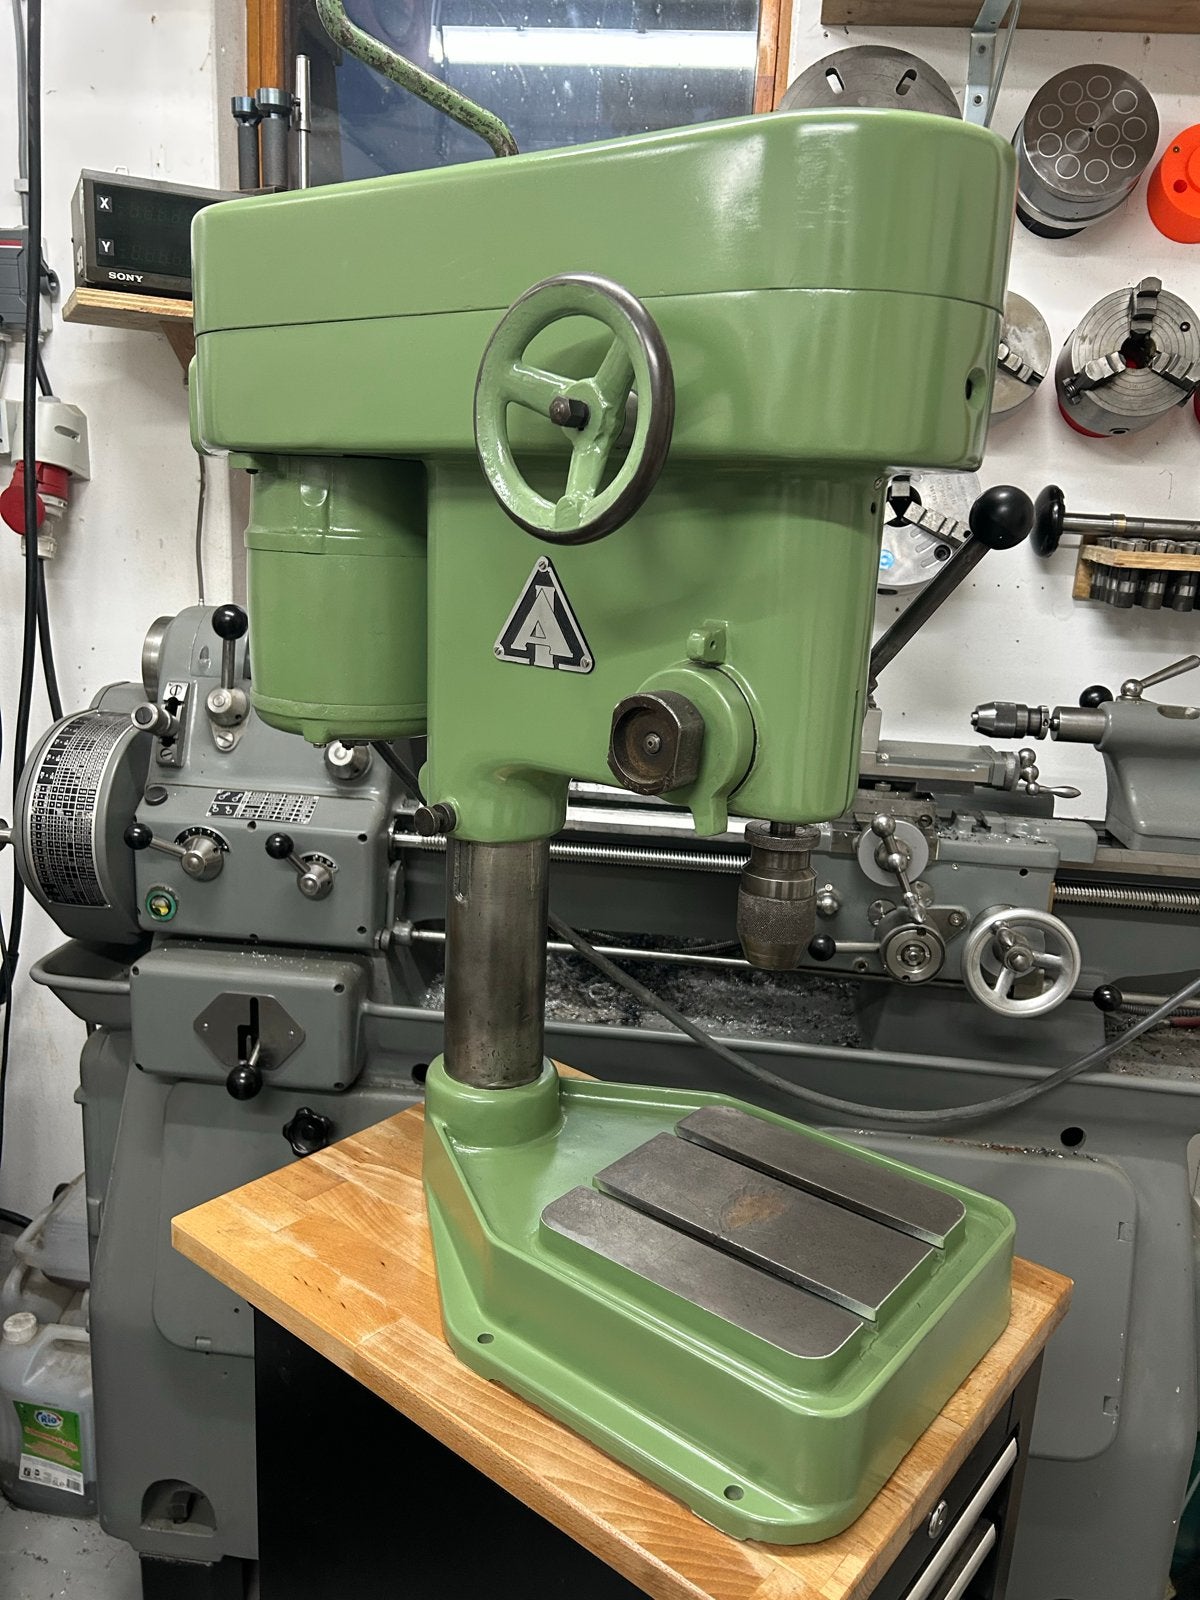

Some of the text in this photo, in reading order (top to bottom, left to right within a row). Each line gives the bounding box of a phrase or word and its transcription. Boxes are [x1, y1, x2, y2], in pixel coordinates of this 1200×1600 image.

[100, 197, 109, 209] X
[102, 241, 111, 252] Y
[108, 271, 144, 283] SONY
